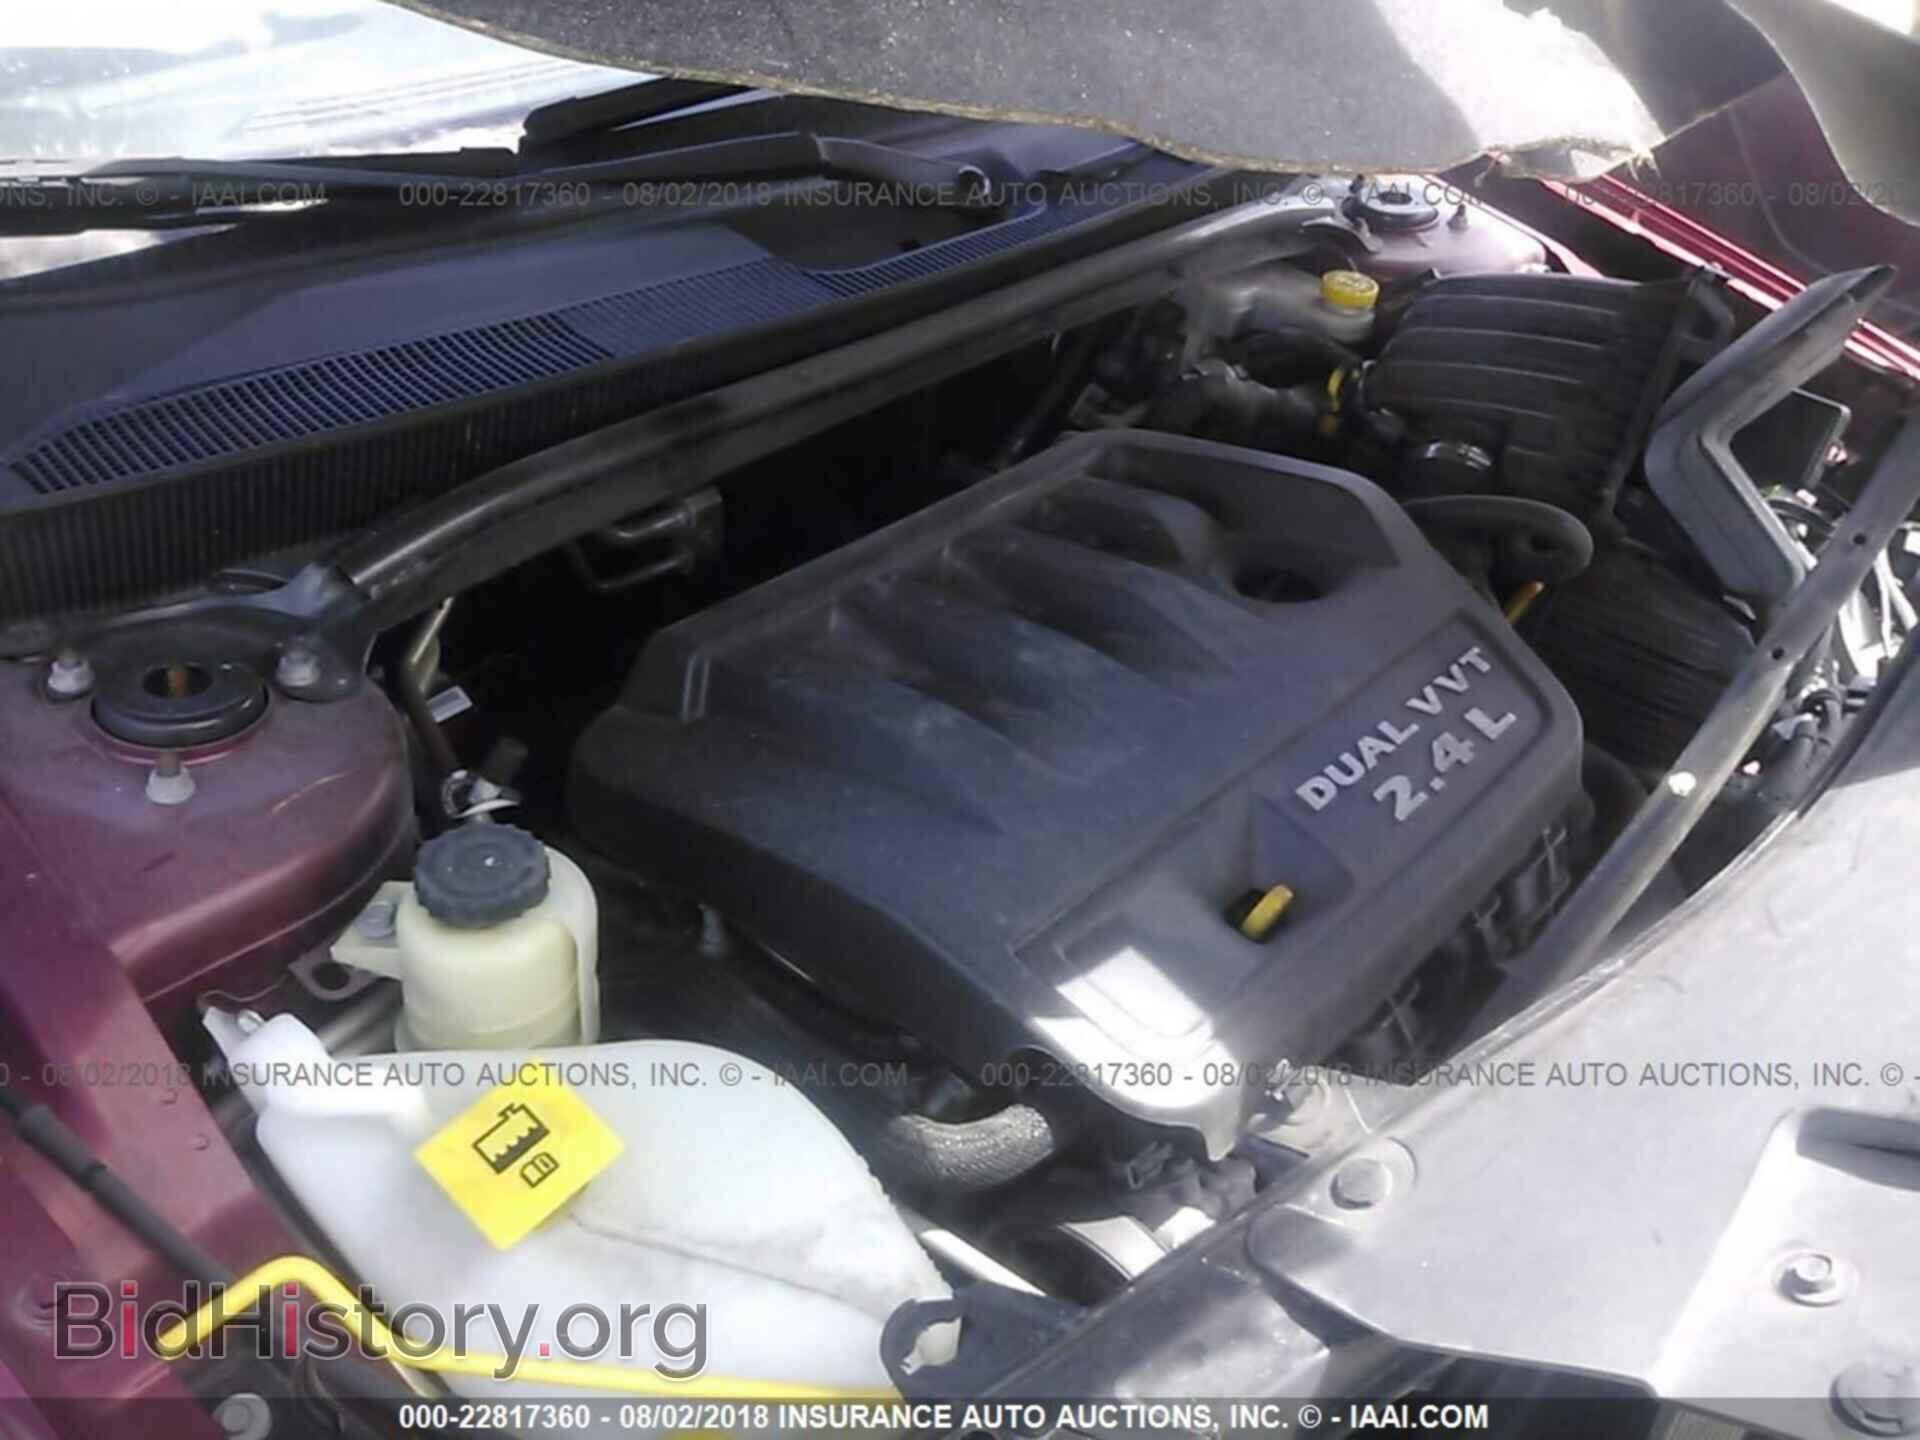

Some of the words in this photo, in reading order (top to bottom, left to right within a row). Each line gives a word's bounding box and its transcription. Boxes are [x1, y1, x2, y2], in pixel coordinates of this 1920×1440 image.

[1296, 721, 1420, 811] DUAL
[1405, 646, 1491, 715] VVT
[1373, 732, 1475, 821] 2.4
[1463, 707, 1517, 740] L
